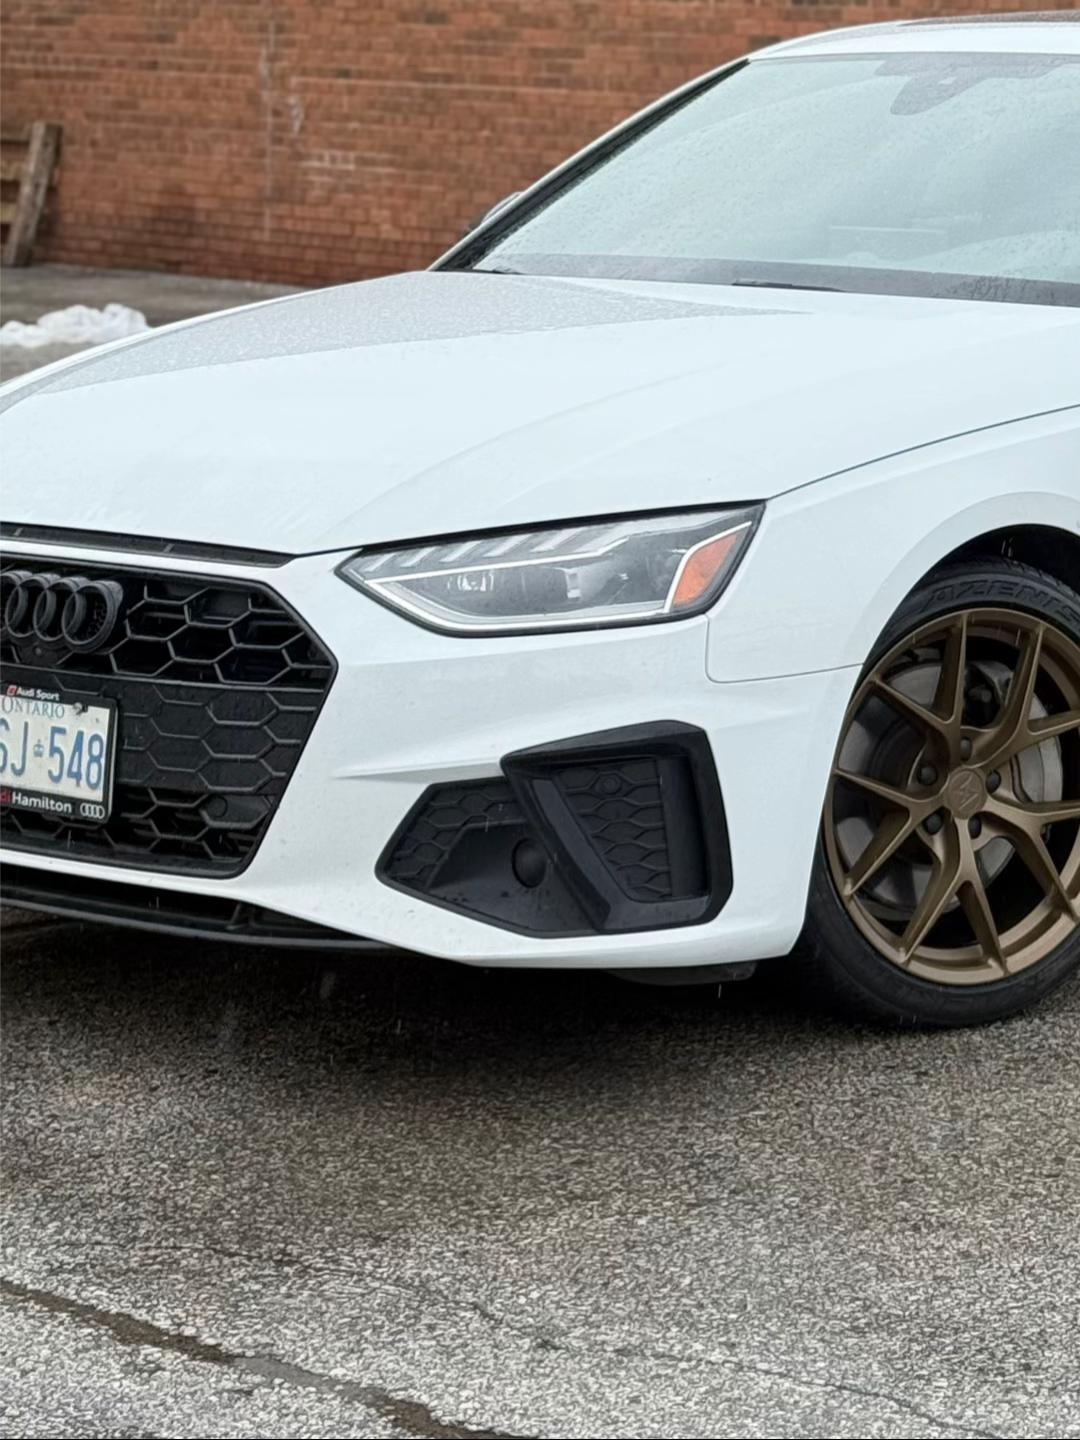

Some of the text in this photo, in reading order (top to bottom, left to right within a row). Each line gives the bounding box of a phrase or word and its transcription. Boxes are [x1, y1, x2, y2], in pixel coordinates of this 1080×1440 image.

[16, 686, 60, 701] Audi Sport
[1, 696, 65, 719] ONTARIO
[47, 726, 104, 790] 548
[12, 791, 72, 814] Hamilton
